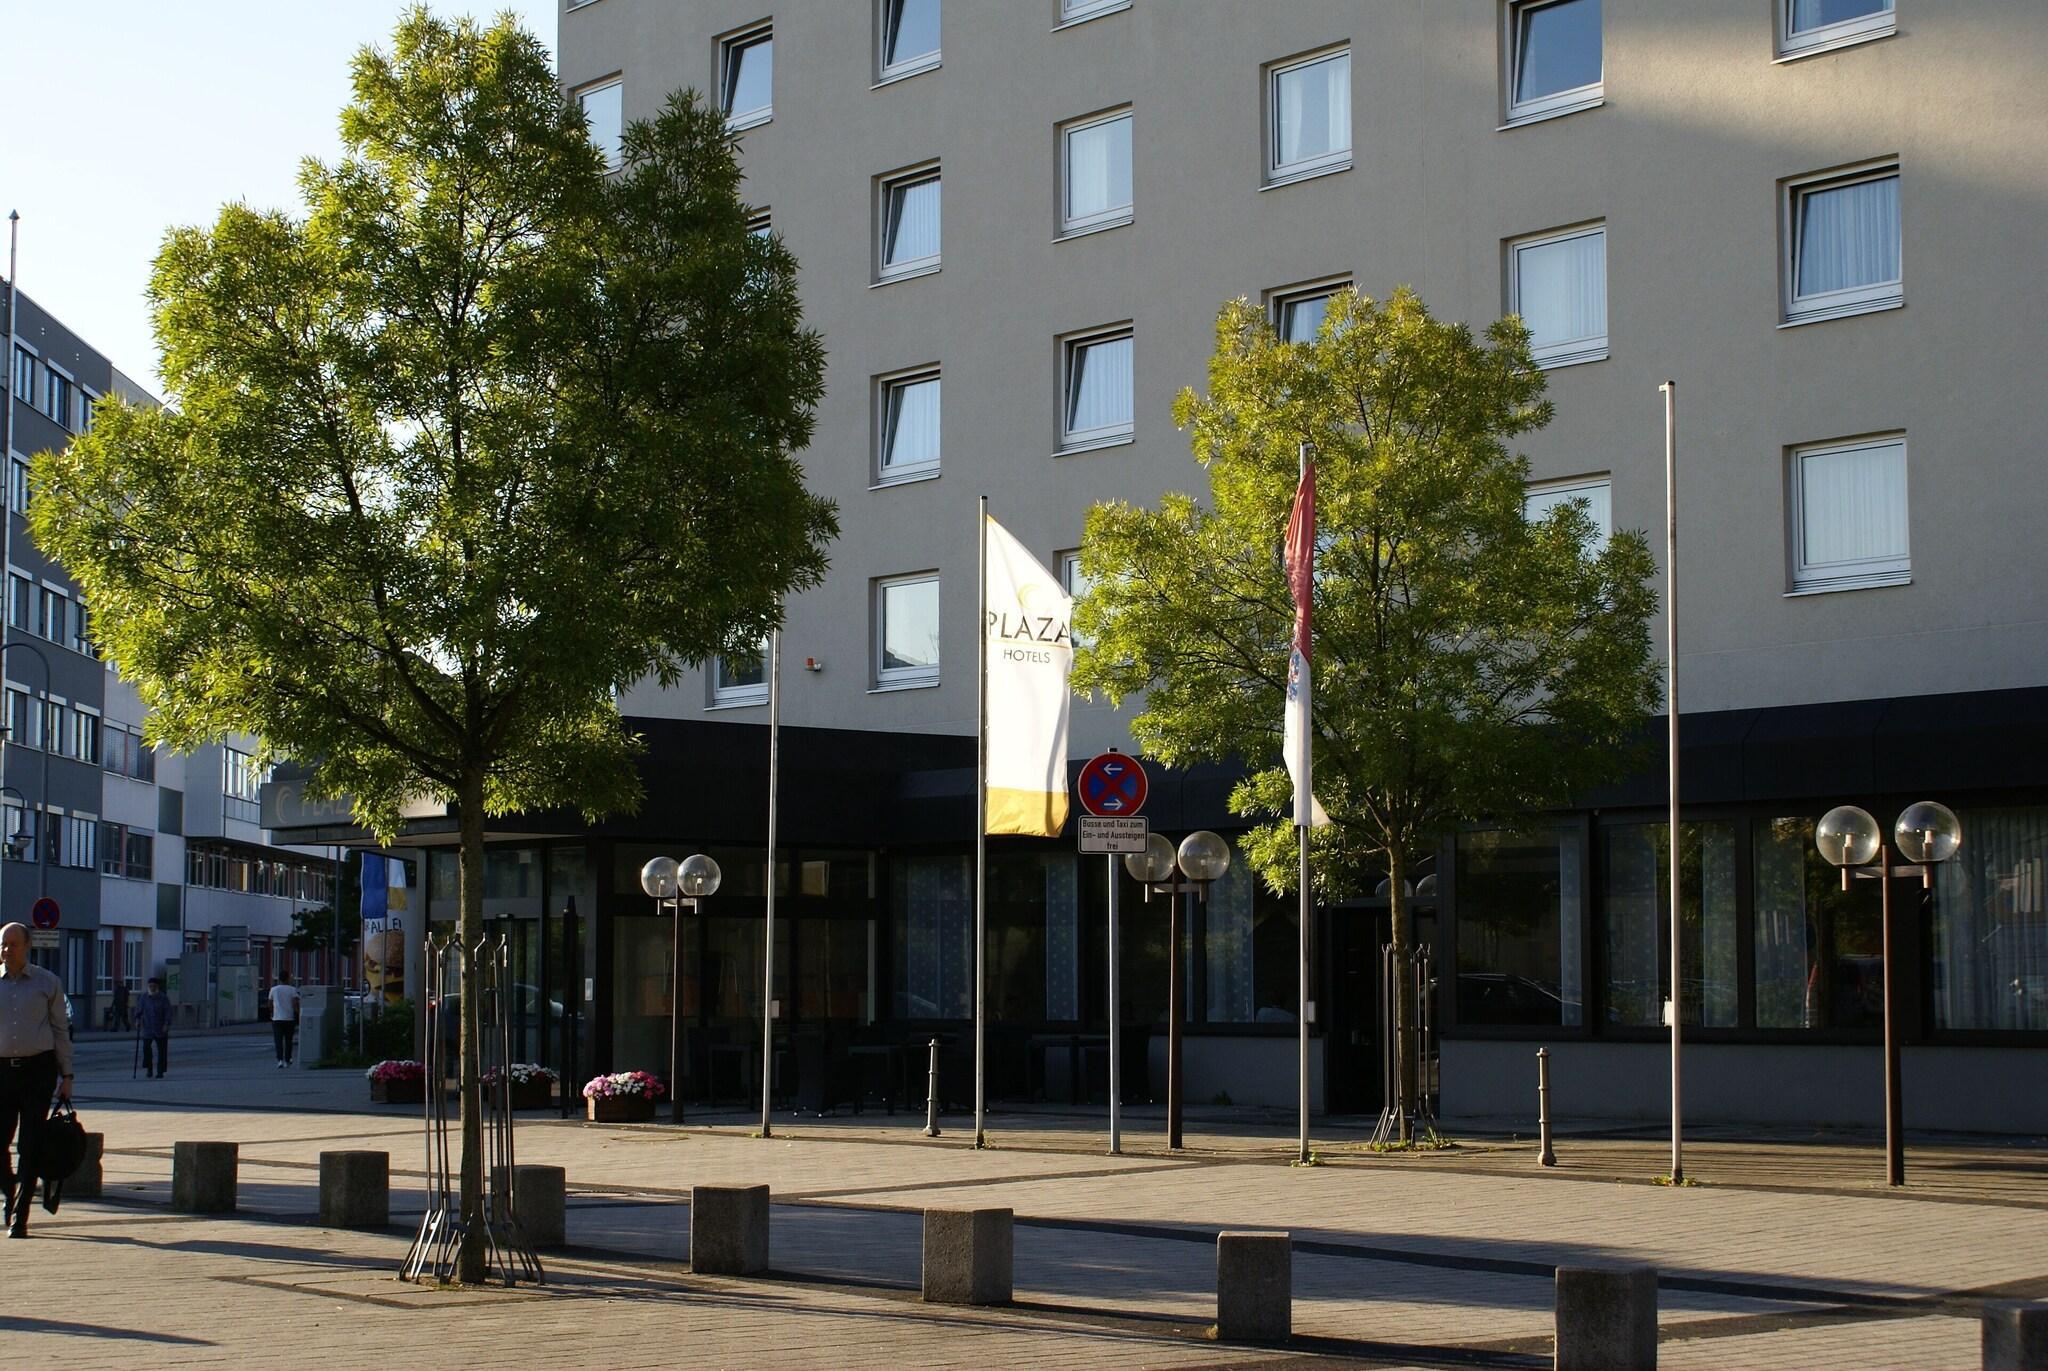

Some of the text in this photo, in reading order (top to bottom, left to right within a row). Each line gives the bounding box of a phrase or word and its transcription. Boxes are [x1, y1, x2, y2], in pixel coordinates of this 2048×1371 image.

[988, 611, 1069, 643] PLAZA
[1003, 649, 1051, 664] HOTELS
[1082, 820, 1102, 828] Busse
[1102, 820, 1115, 828] und
[1116, 820, 1129, 828] Taxi
[1082, 831, 1145, 841] Ein- und Aussteigen
[1106, 842, 1119, 850] frei
